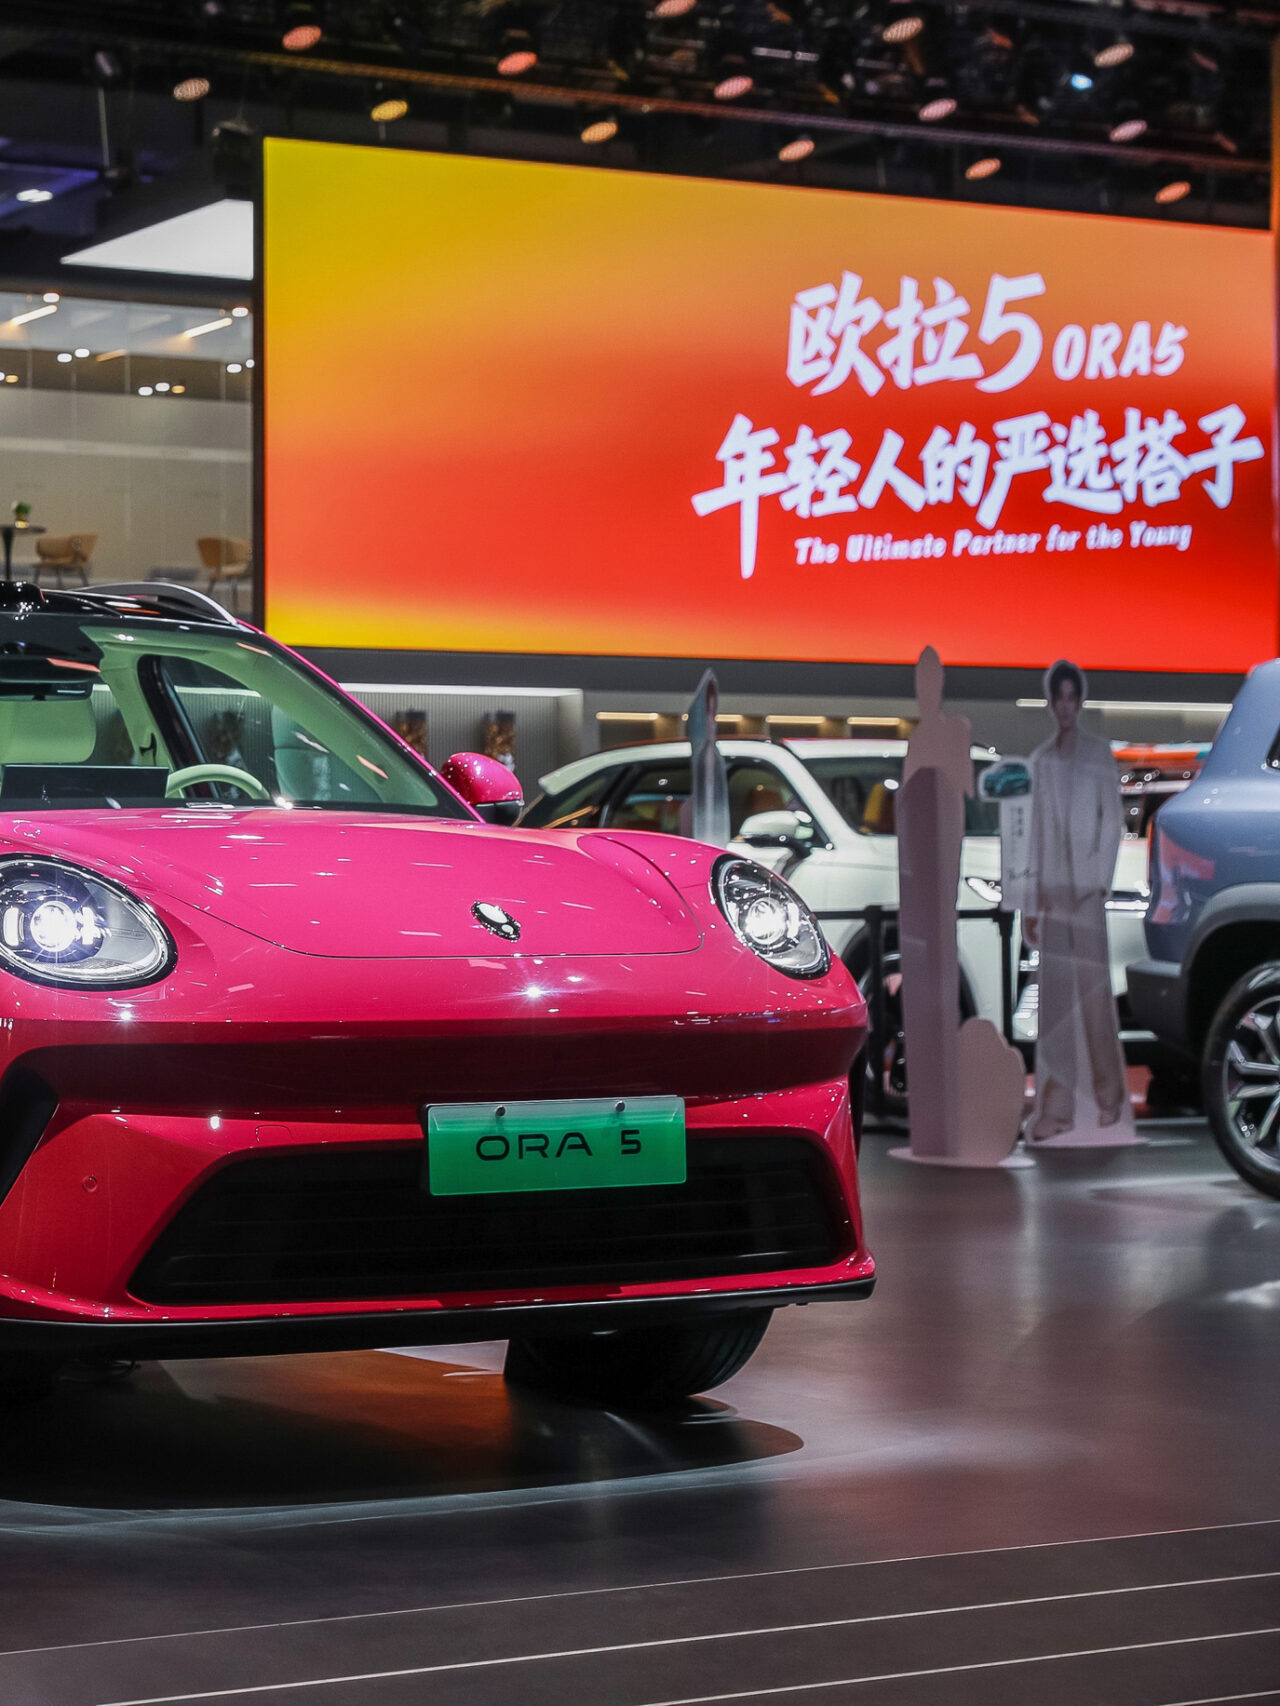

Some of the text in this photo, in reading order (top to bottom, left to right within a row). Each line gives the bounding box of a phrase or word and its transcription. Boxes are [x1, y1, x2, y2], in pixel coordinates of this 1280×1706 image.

[786, 270, 1189, 397] 欧拉5 ORA5
[690, 403, 1265, 580] 年轻人的严选搭子
[794, 520, 1193, 565] The Ultimate Partner for the Young
[475, 1129, 642, 1162] ORA 5
